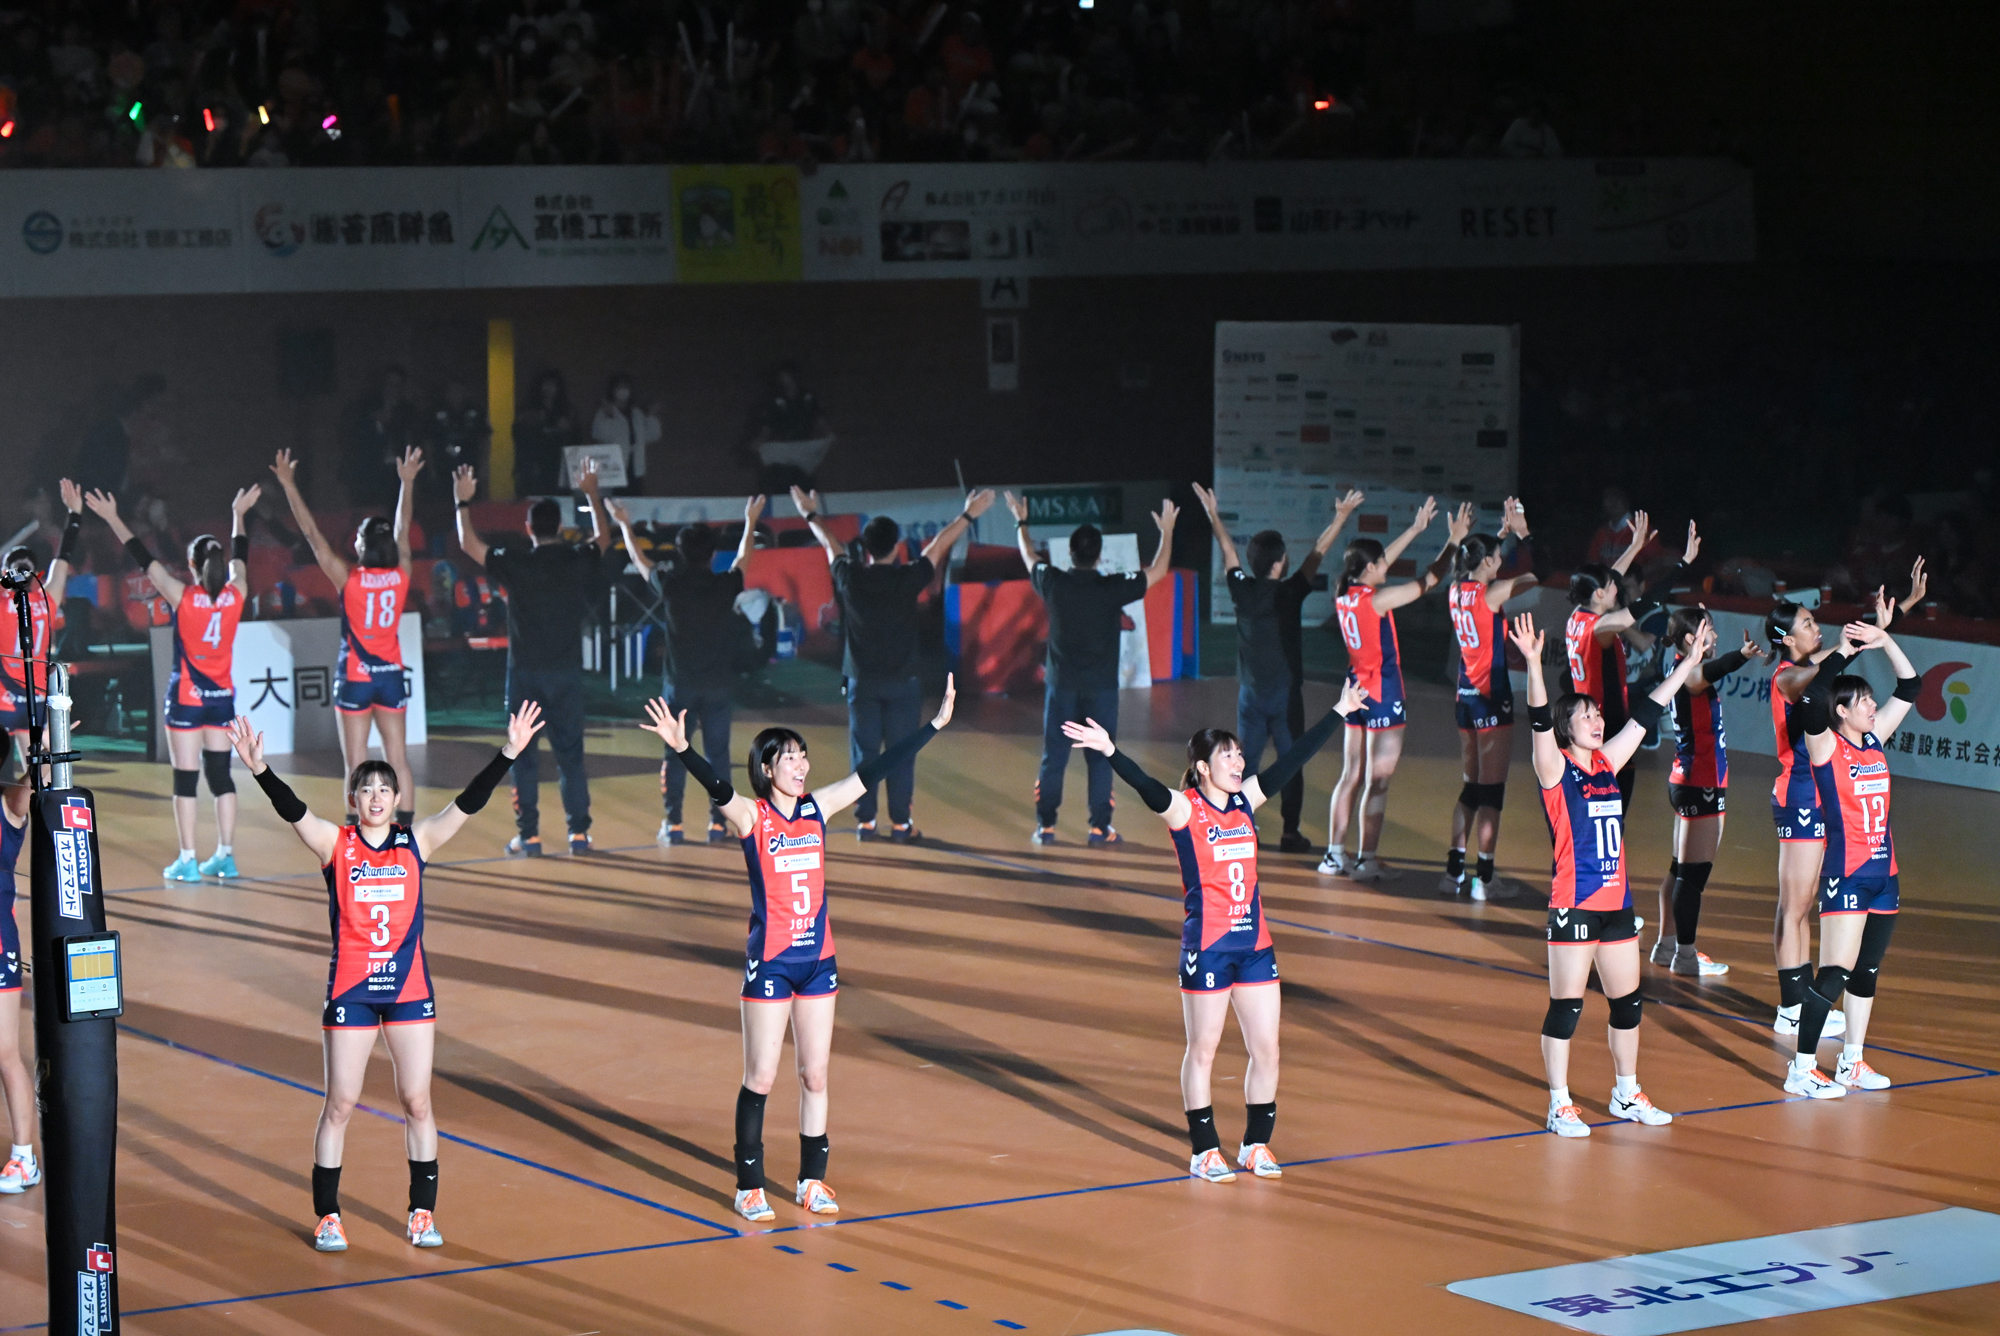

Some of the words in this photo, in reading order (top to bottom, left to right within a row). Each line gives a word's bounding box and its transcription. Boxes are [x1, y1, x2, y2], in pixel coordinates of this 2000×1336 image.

[535, 193, 593, 211] 株式会社
[1460, 206, 1558, 238] RESET
[365, 590, 397, 629] 18
[202, 611, 222, 649] 4
[1452, 607, 1480, 649] 29
[250, 663, 413, 710] 大同
[1367, 716, 1391, 729] era
[72, 809, 88, 826] J
[1677, 803, 1698, 816] era
[1859, 795, 1886, 834] 12
[1594, 817, 1621, 859] 10
[1777, 826, 1792, 838] era
[60, 839, 77, 912] オンデマンド
[76, 831, 89, 886] SPORTS
[790, 872, 811, 915] 5
[1228, 861, 1246, 902] 8
[1843, 894, 1858, 909] 12
[369, 904, 390, 947] 3
[1574, 924, 1588, 940] 10
[764, 980, 774, 997] 5
[1205, 972, 1215, 988] 8
[336, 1006, 346, 1024] 3
[96, 1254, 109, 1269] J
[99, 1273, 108, 1324] SPORTS
